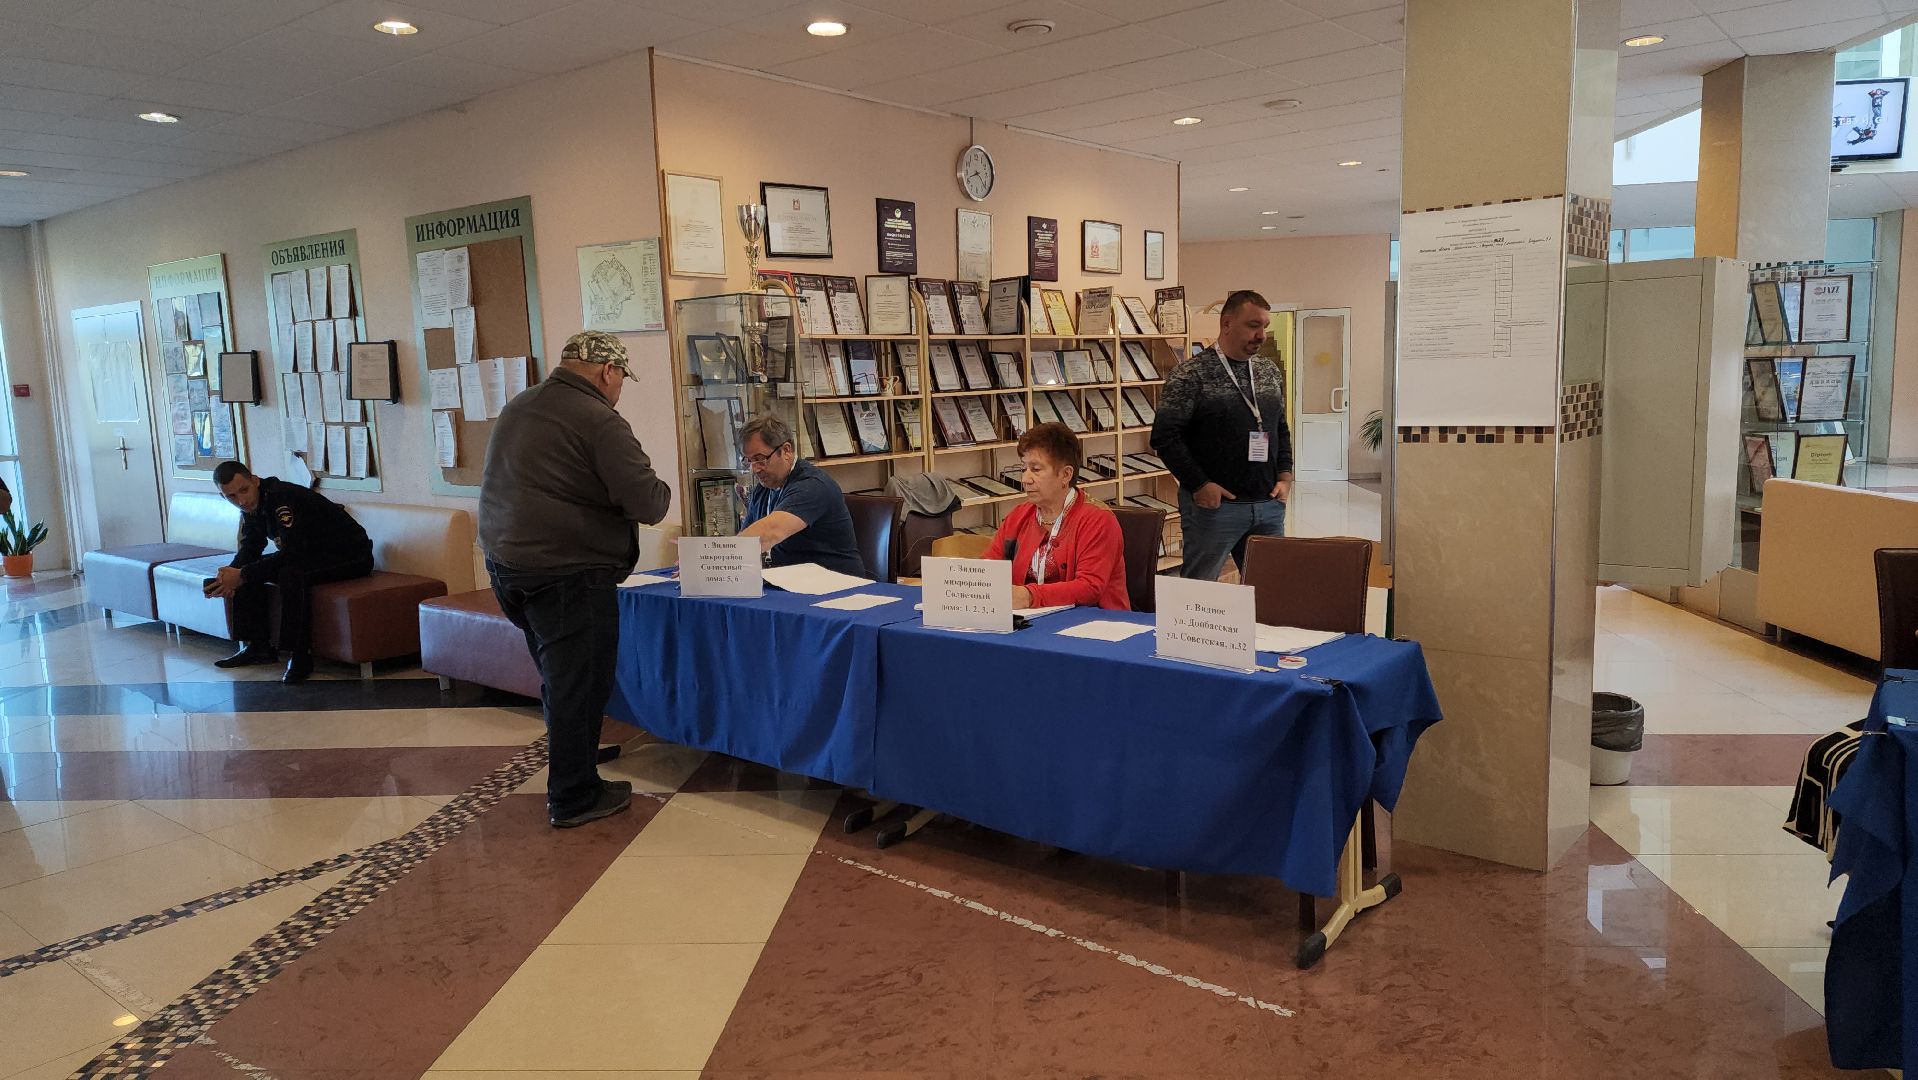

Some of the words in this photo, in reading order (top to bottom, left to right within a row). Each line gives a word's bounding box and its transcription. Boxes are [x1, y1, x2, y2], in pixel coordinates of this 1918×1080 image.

[415, 208, 521, 242] ИНФОРМАЦИЯ
[271, 239, 346, 266] ОБЪЯВЛЕНИЯ
[154, 266, 218, 289] ИНФОРМАЦИЯ
[943, 579, 991, 588] микрорайон
[945, 589, 991, 600] Солнечный
[1194, 603, 1226, 615] Видное
[1173, 618, 1186, 626] ул.
[1187, 618, 1239, 634] Донбасская
[1166, 632, 1178, 641] ул.
